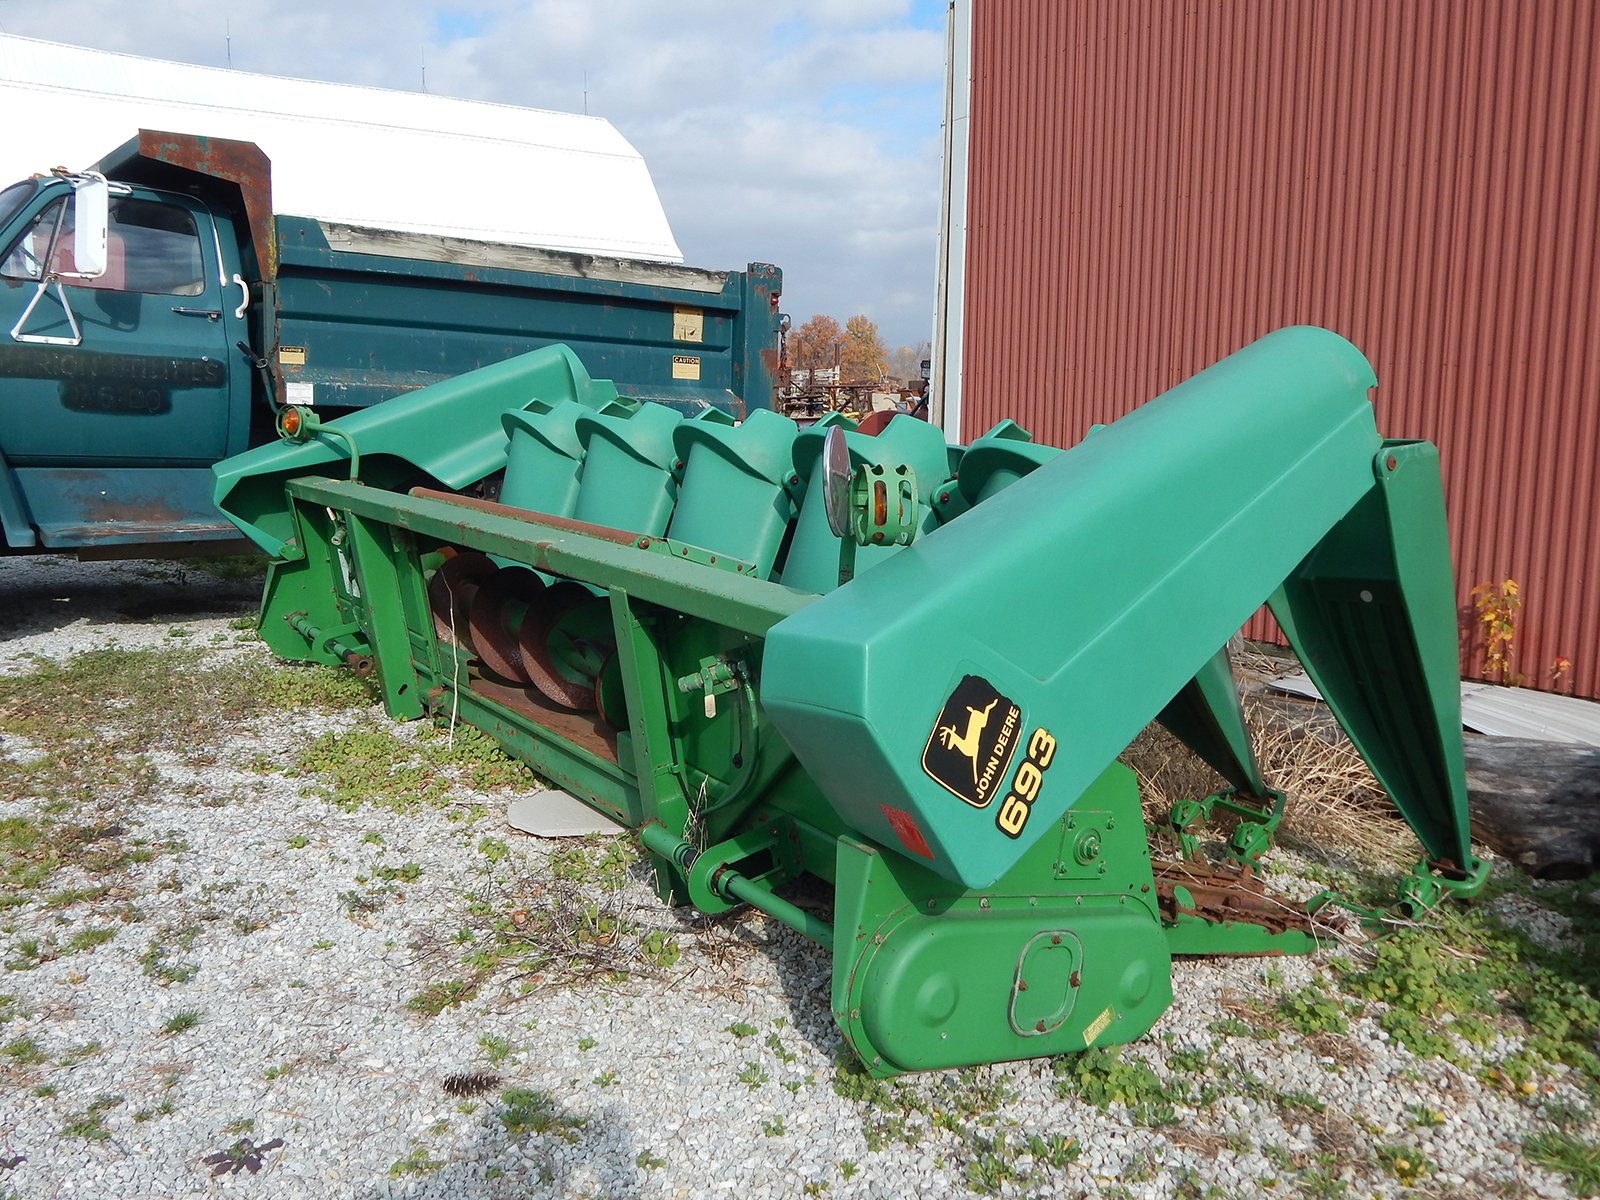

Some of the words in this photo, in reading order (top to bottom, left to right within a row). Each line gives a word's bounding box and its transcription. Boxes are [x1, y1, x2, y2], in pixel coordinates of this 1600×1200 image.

[975, 757, 1000, 799] JOHN
[995, 706, 1020, 757] DEERE
[996, 727, 1057, 838] 693
